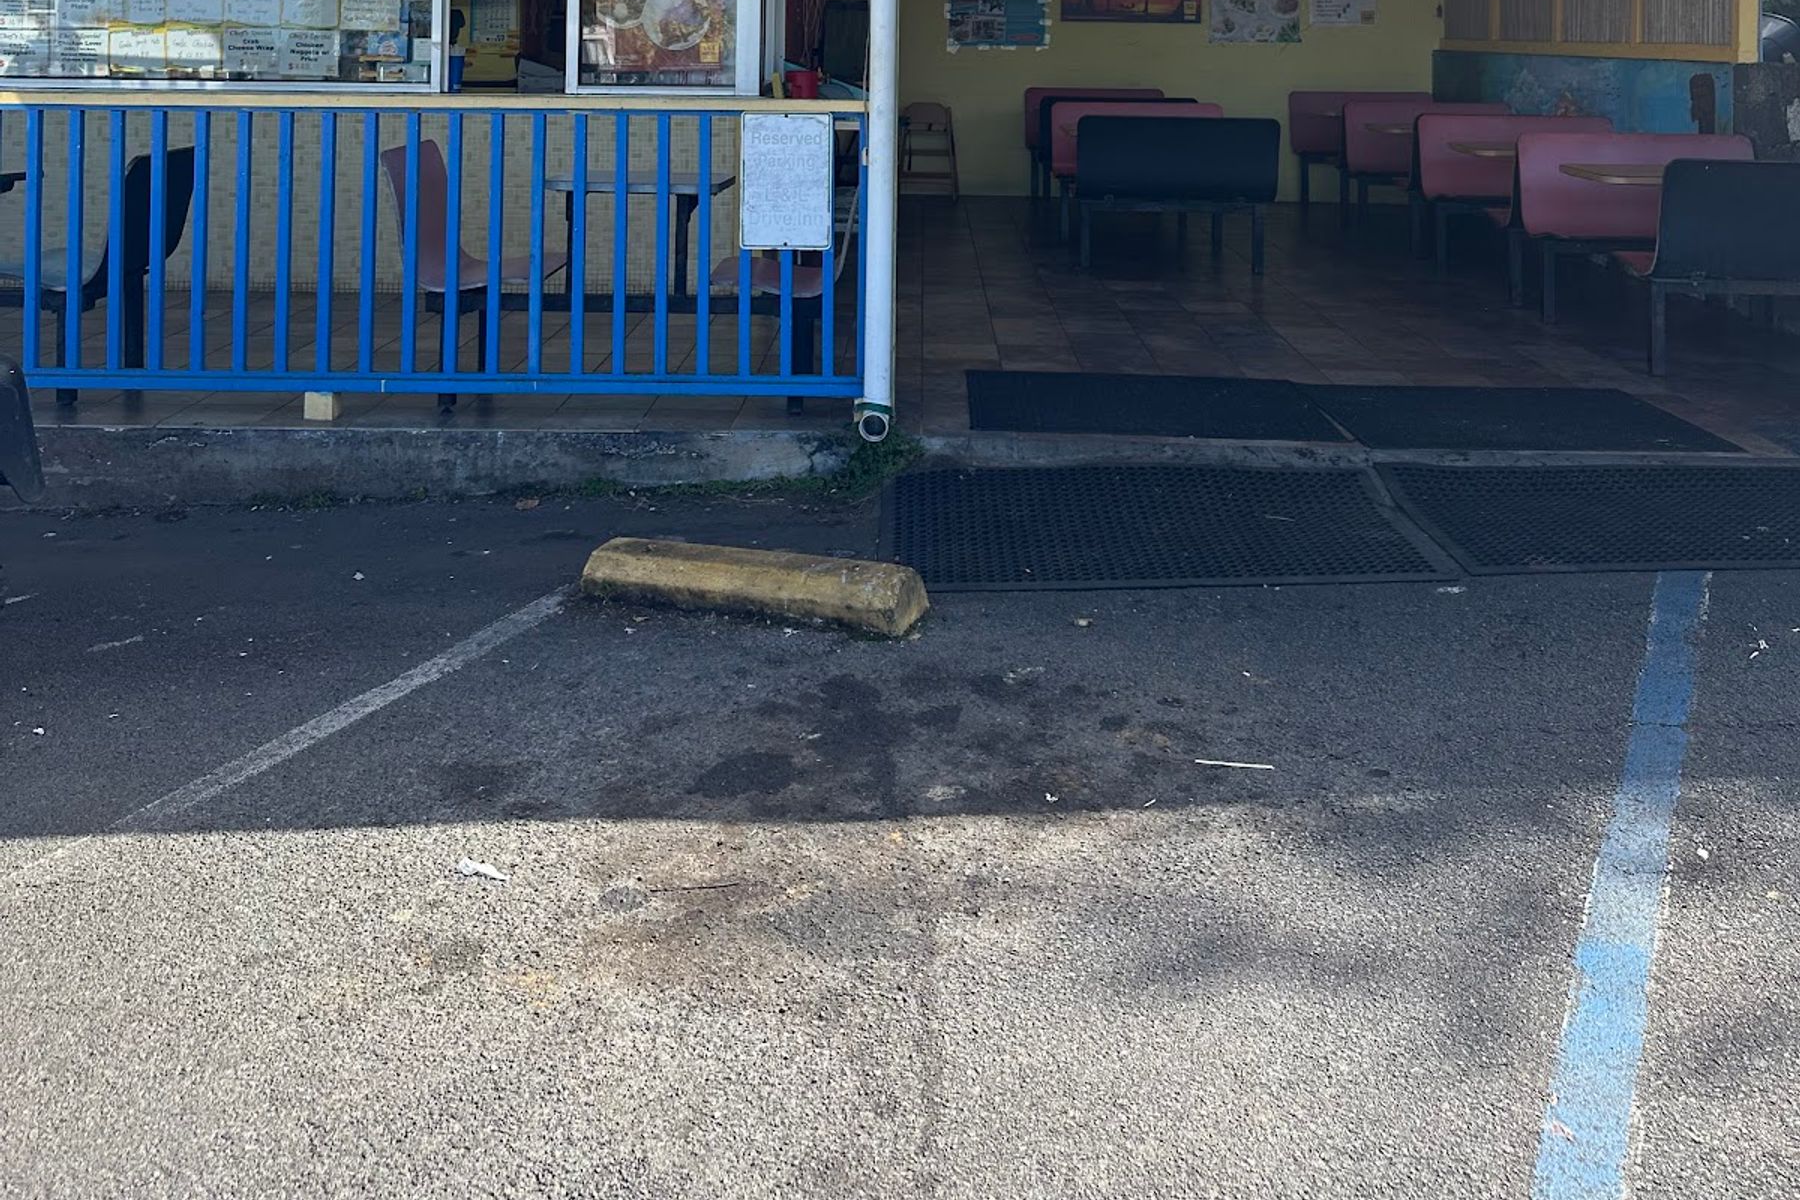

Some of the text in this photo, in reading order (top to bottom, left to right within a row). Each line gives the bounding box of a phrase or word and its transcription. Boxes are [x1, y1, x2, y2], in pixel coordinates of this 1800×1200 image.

[256, 44, 275, 52] Wrap
[290, 48, 320, 56] Nuggets
[751, 131, 822, 146] Reserved
[757, 154, 816, 172] Parking
